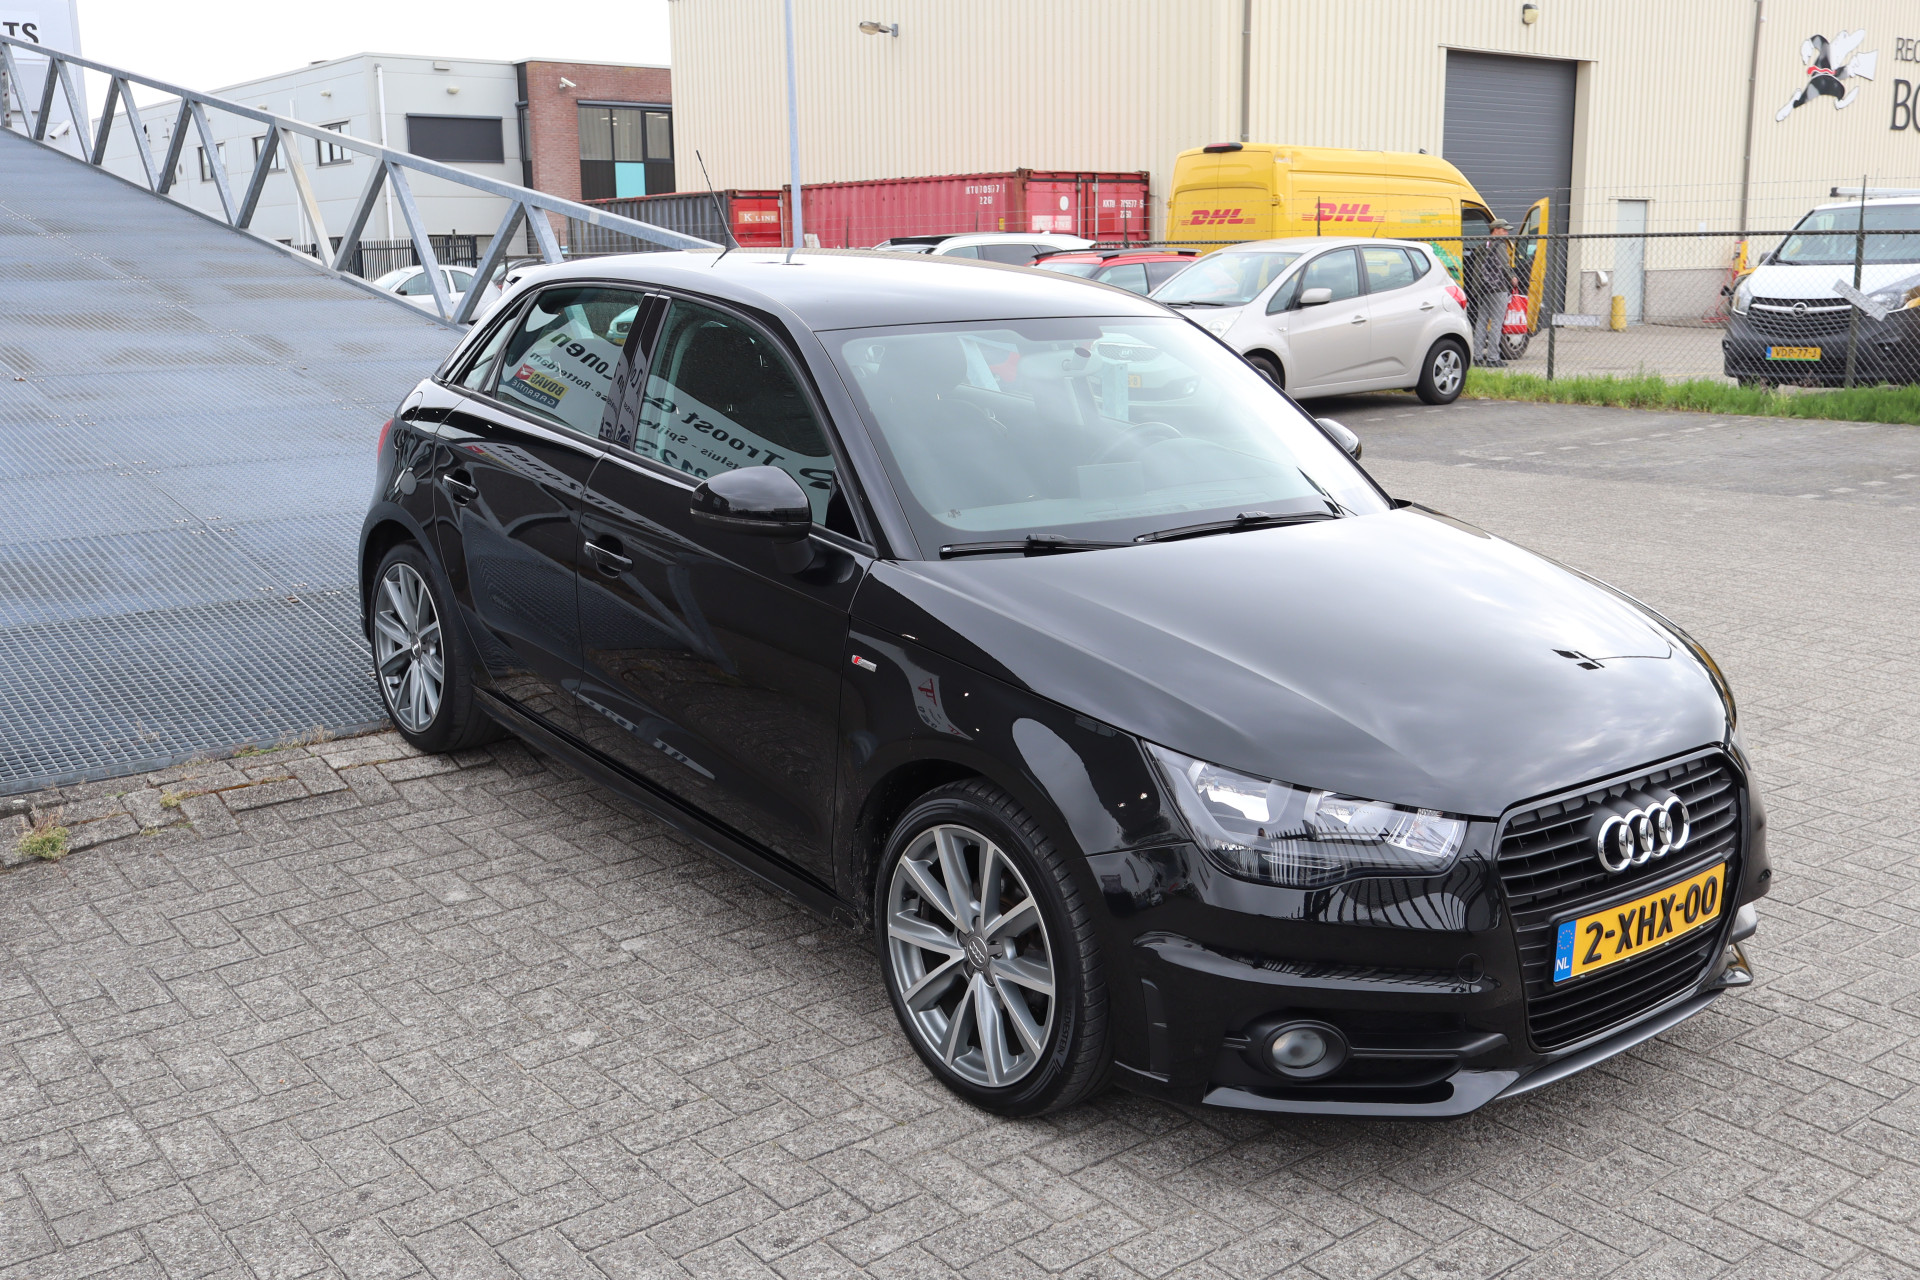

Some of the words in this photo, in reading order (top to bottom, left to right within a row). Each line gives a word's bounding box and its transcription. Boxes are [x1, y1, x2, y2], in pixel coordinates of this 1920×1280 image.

[744, 213, 752, 221] K
[1190, 208, 1244, 225] DHL
[1314, 203, 1376, 222] DHL
[1775, 348, 1817, 358] VDP-77-J
[1582, 875, 1718, 965] 2-XHX-00
[1555, 956, 1570, 972] NL
